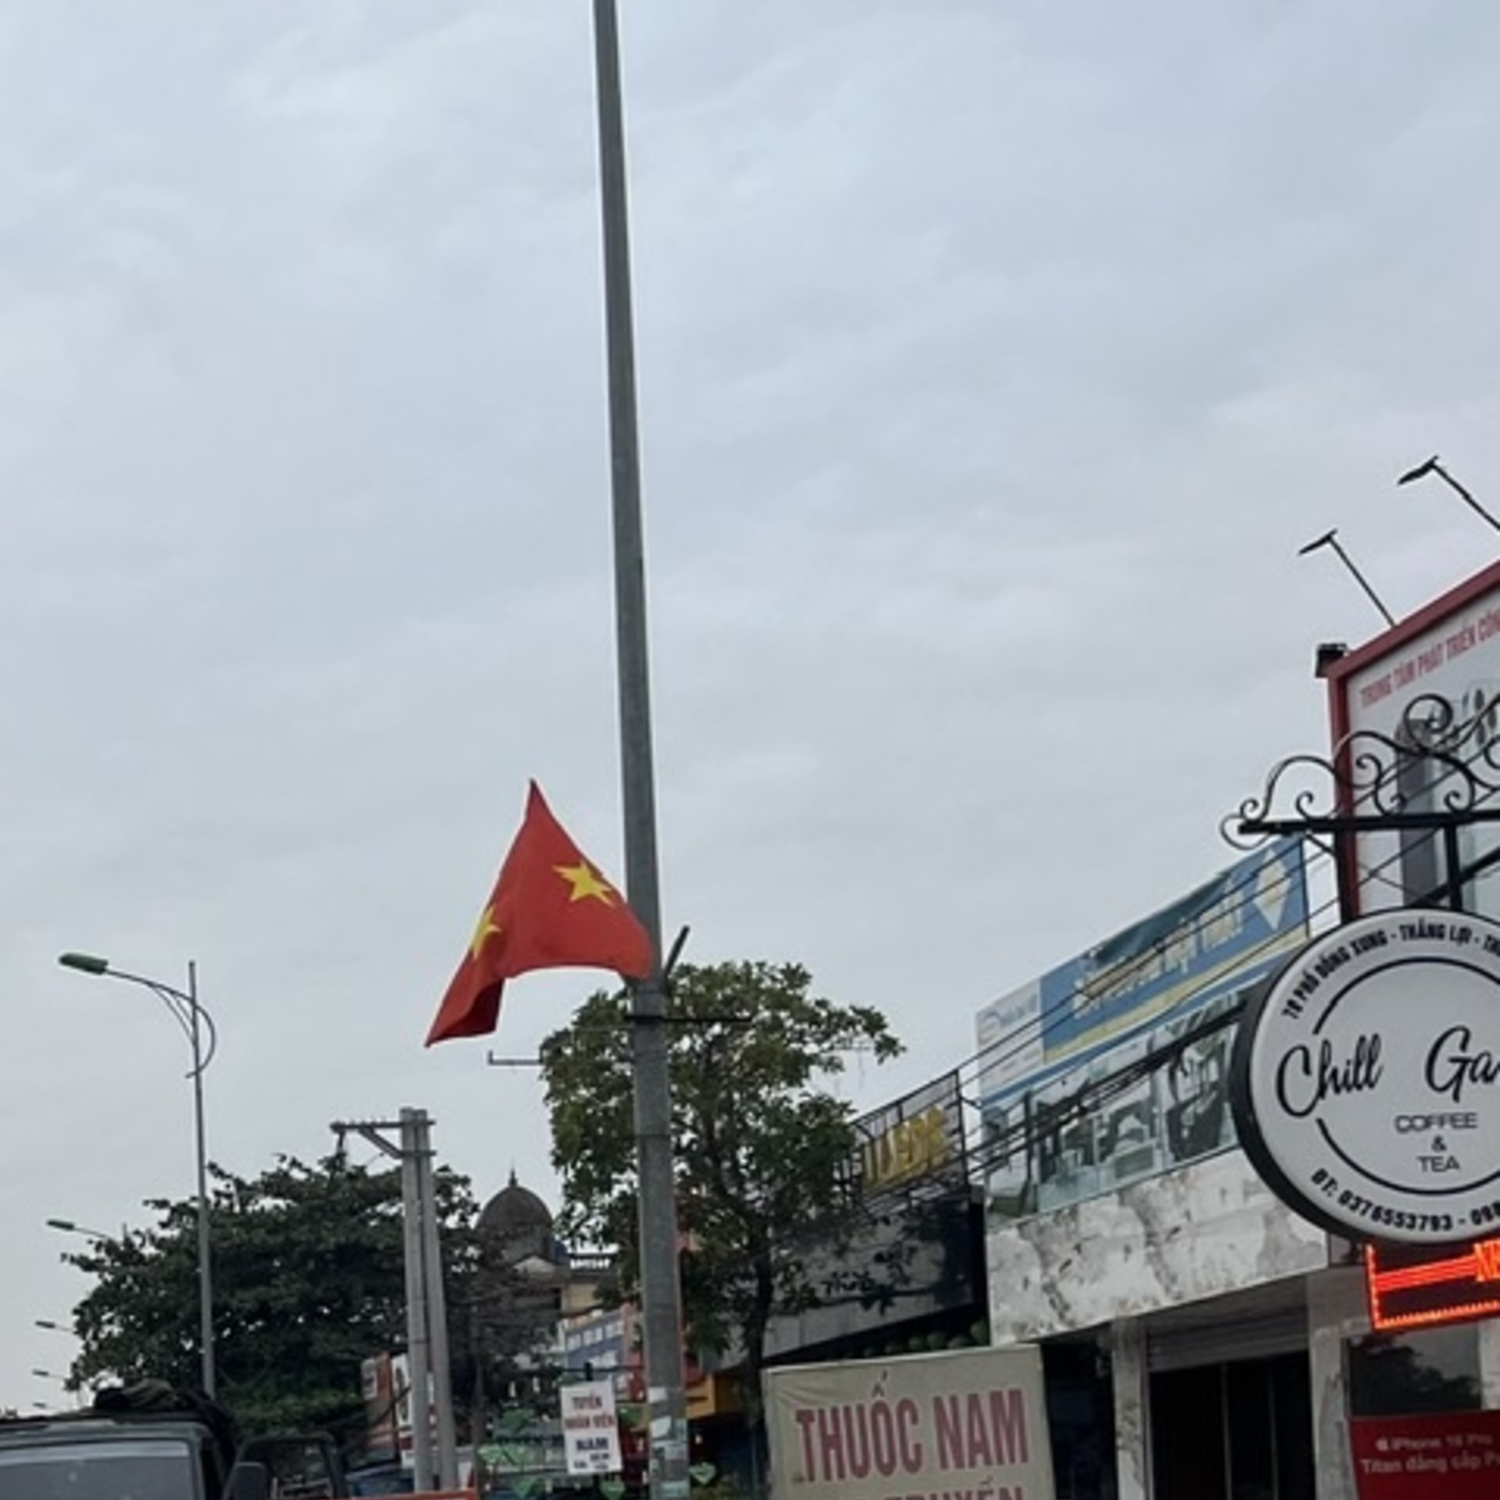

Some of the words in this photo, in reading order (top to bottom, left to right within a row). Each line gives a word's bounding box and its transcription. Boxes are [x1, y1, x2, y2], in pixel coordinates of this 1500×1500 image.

[1276, 1032, 1383, 1119] Chill
[1394, 1112, 1479, 1133] COFFEE
[1431, 1135, 1448, 1152] &
[1416, 1155, 1460, 1174] TEA
[796, 1371, 923, 1483] THUỐC
[934, 1389, 1029, 1471] NAM
[1360, 1458, 1403, 1475] Titan
